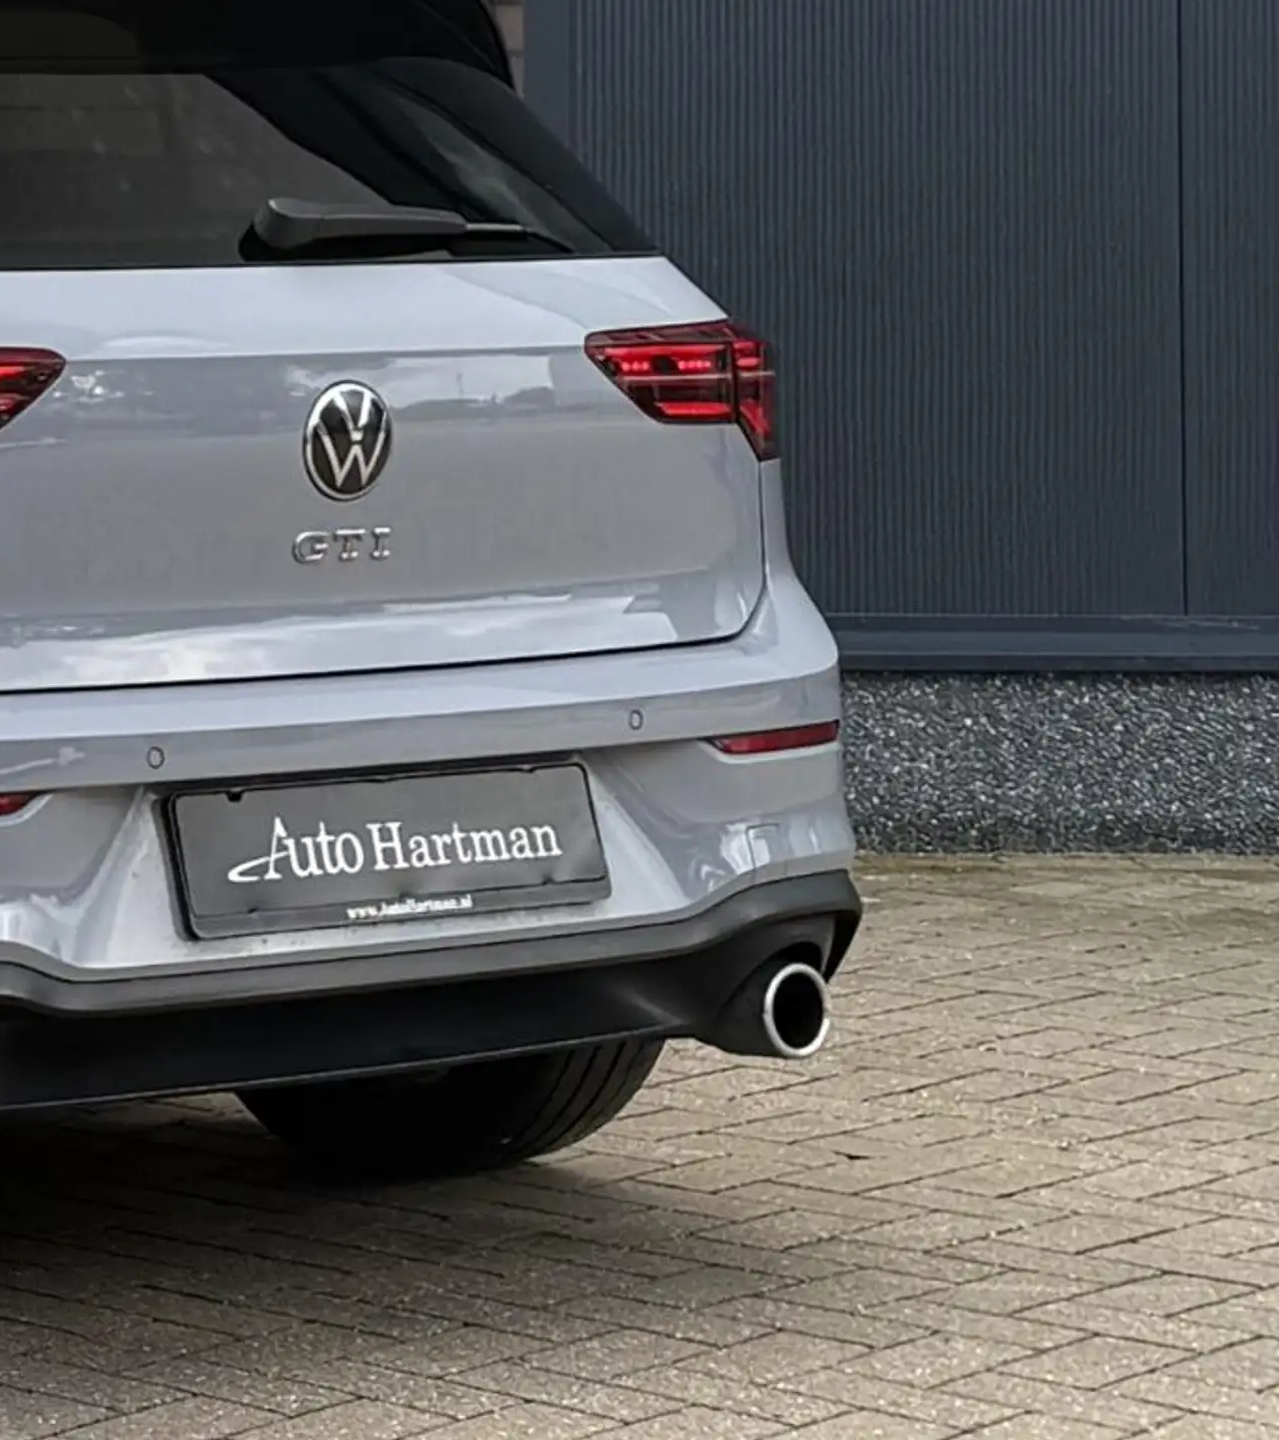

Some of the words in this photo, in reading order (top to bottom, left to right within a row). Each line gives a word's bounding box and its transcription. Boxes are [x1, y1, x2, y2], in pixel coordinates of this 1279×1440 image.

[292, 526, 392, 564] GTI
[227, 816, 364, 883] Auto
[366, 821, 563, 871] Hartman
